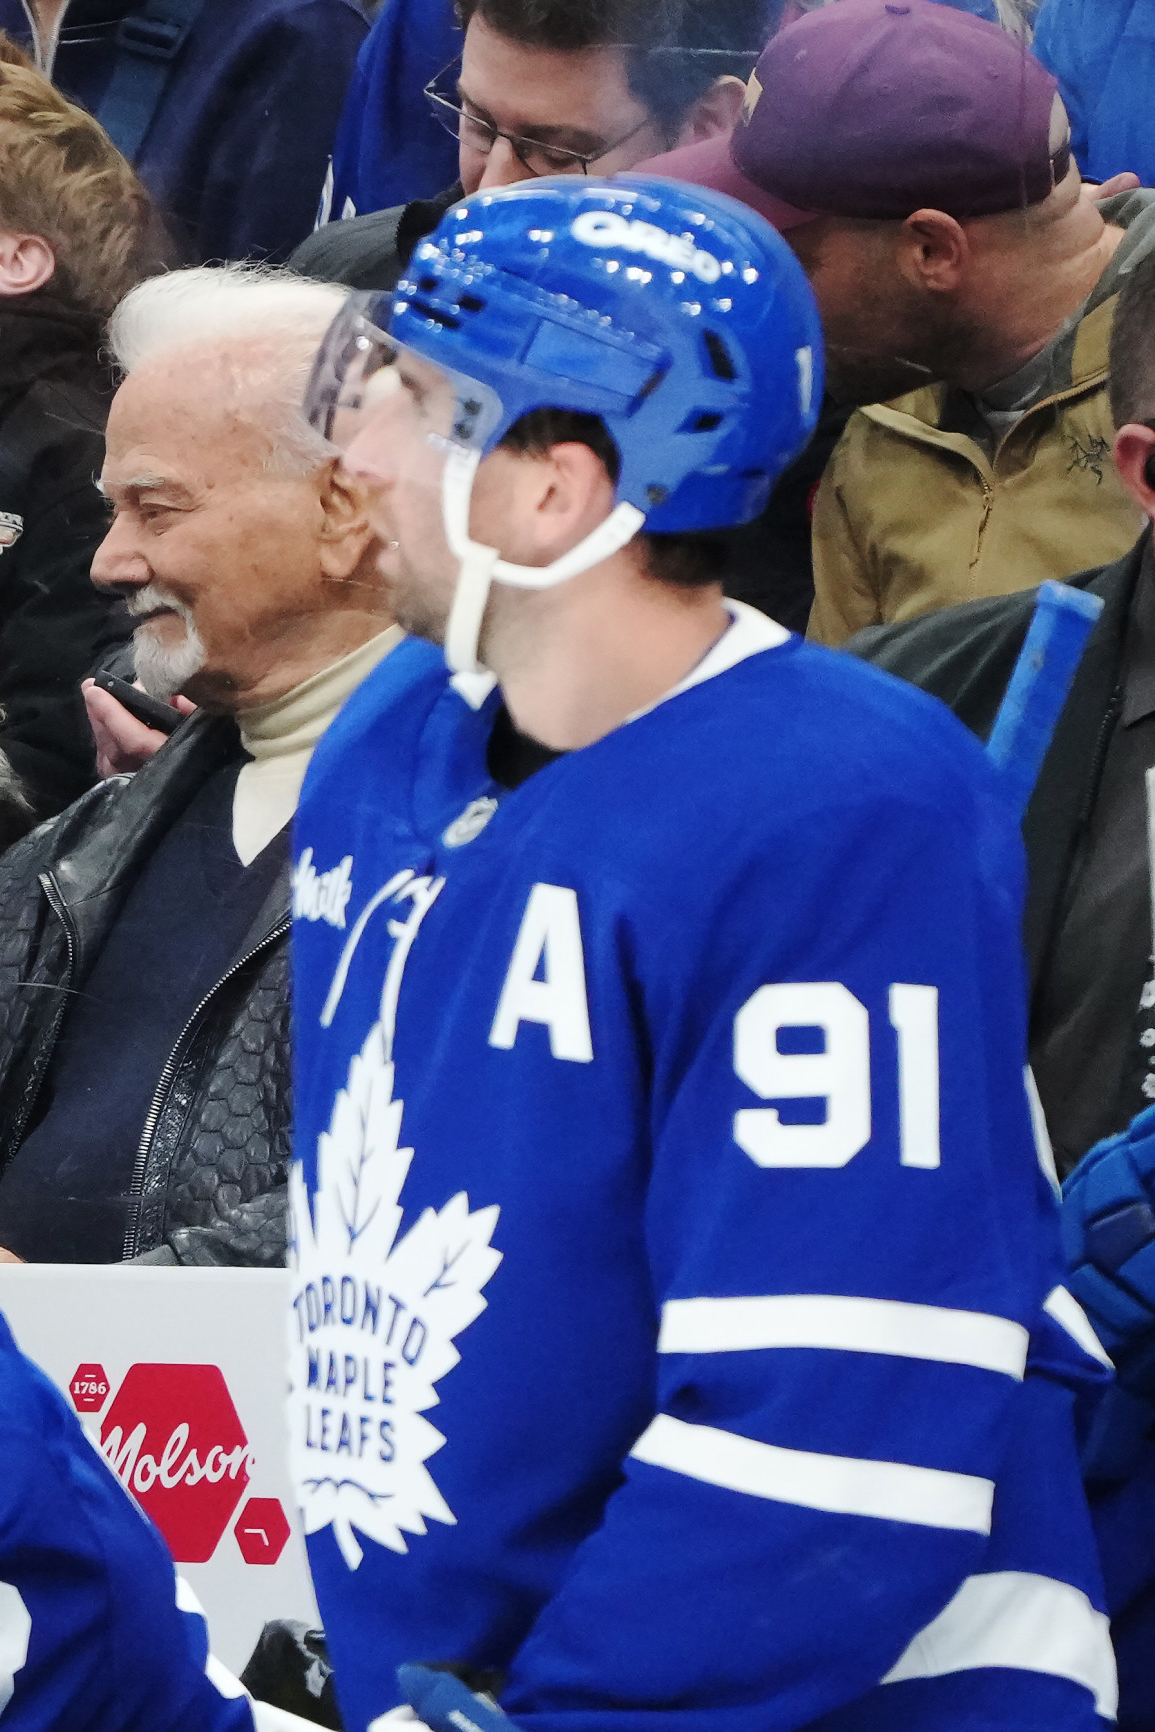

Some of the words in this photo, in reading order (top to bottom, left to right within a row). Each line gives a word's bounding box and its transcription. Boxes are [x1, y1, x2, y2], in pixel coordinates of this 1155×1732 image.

[489, 882, 594, 1063] A
[733, 980, 941, 1170] 91
[293, 1275, 427, 1366] TORONTO
[73, 1381, 107, 1395] 1786
[307, 1346, 397, 1404] MAPLE
[100, 1421, 256, 1494] Molson
[306, 1403, 396, 1462] LEAFS
